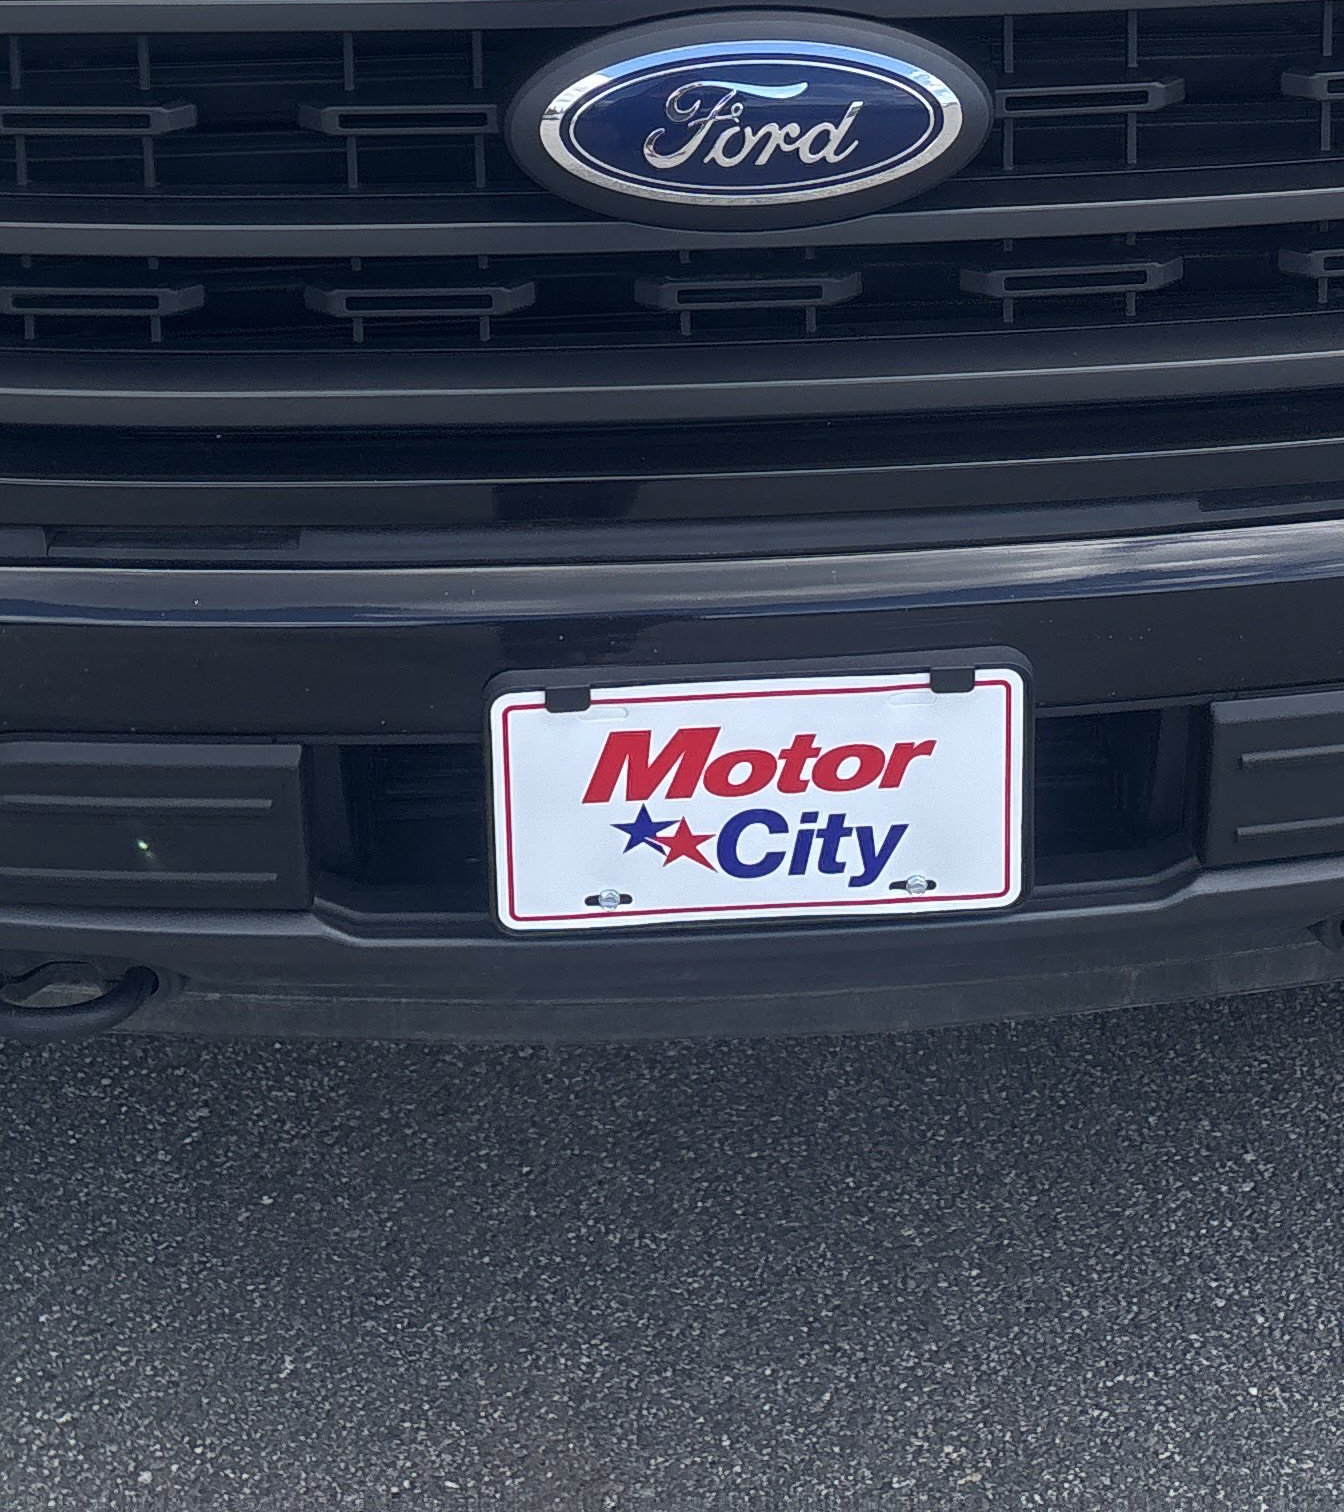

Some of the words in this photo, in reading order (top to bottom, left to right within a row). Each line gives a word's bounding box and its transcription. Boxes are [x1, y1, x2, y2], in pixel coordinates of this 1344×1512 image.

[643, 80, 864, 169] Ford
[581, 726, 937, 805] Motor
[716, 808, 909, 888] City
